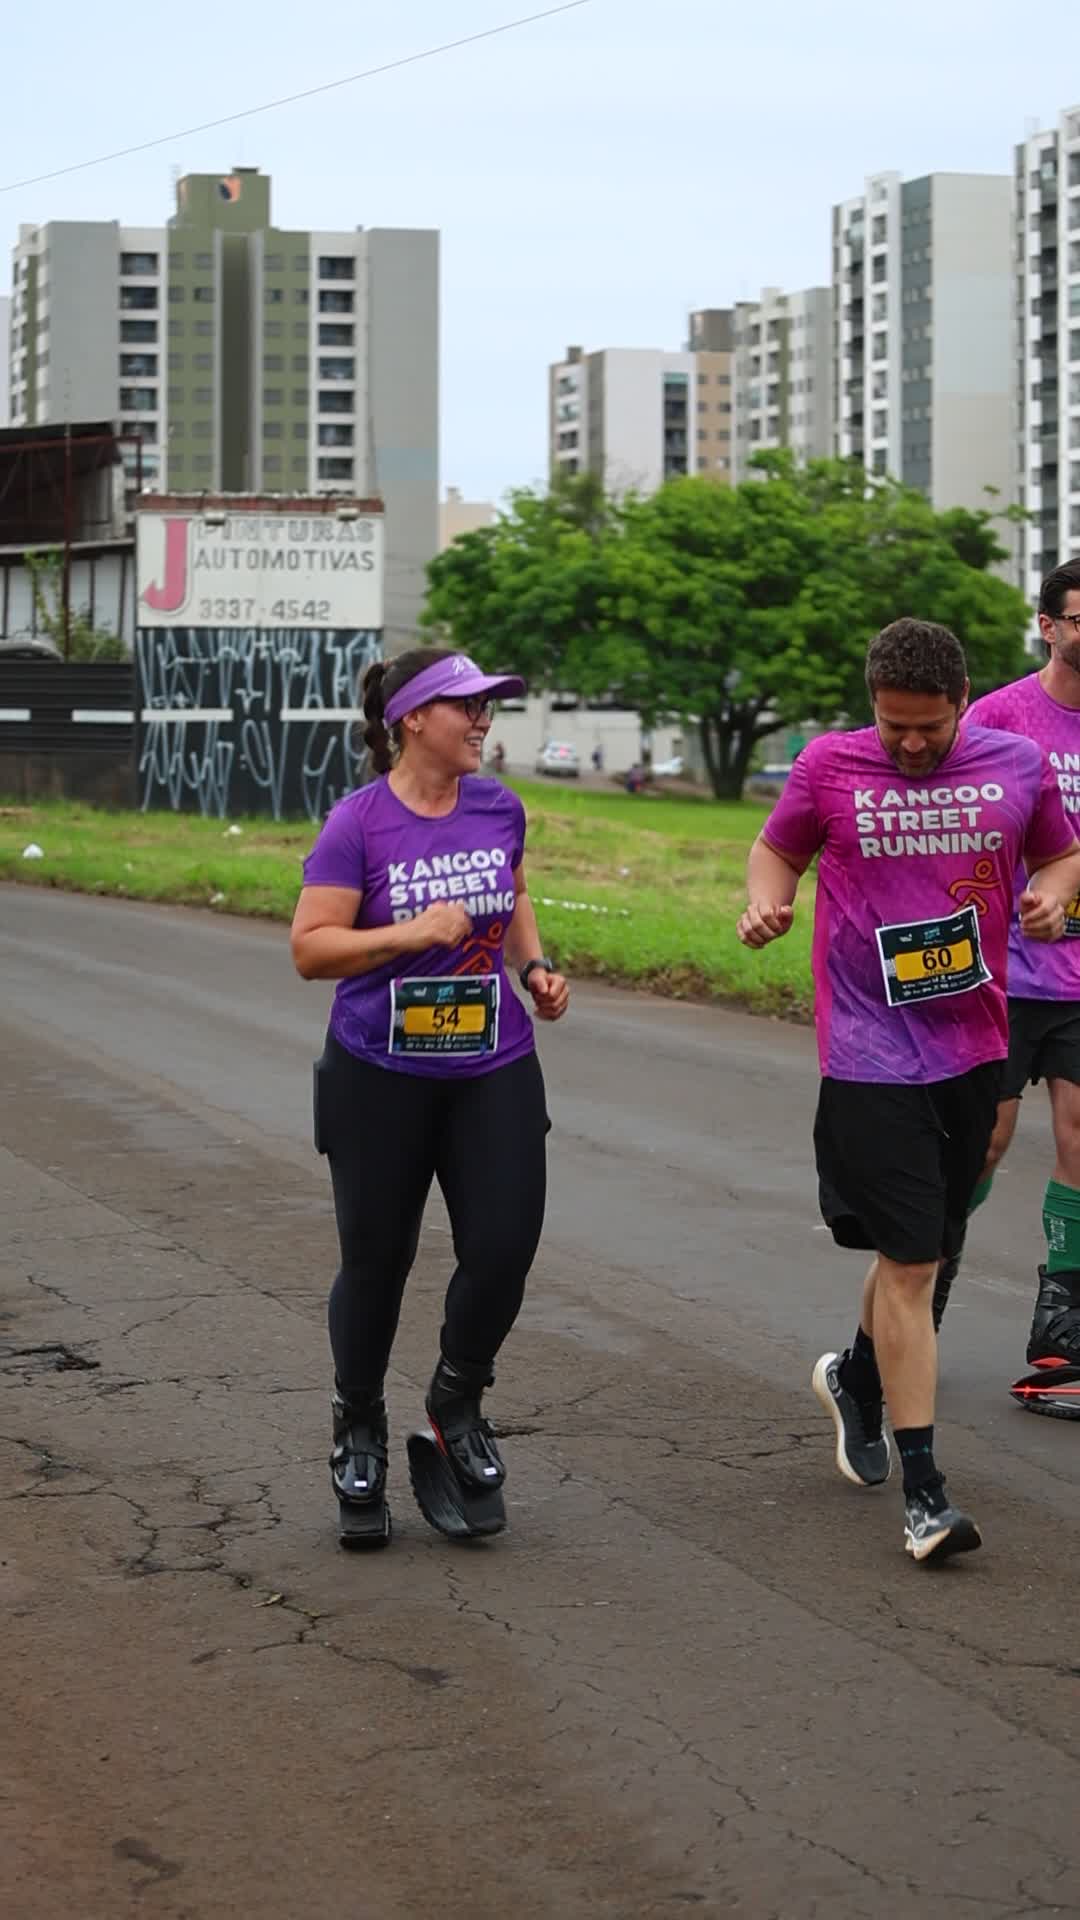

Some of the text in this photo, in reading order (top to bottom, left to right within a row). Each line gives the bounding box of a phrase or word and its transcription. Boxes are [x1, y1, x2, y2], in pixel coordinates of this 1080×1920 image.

[196, 518, 375, 543] PINTURAS
[142, 517, 190, 613] J
[194, 548, 375, 571] AUTOMOTIVAS
[853, 783, 1004, 809] KANGOO
[855, 806, 982, 833] STREET
[859, 831, 1003, 858] RUNNING
[388, 847, 506, 884] KANGOO
[389, 869, 498, 907] STREET
[922, 947, 952, 971] 60
[432, 1006, 460, 1029] 54
